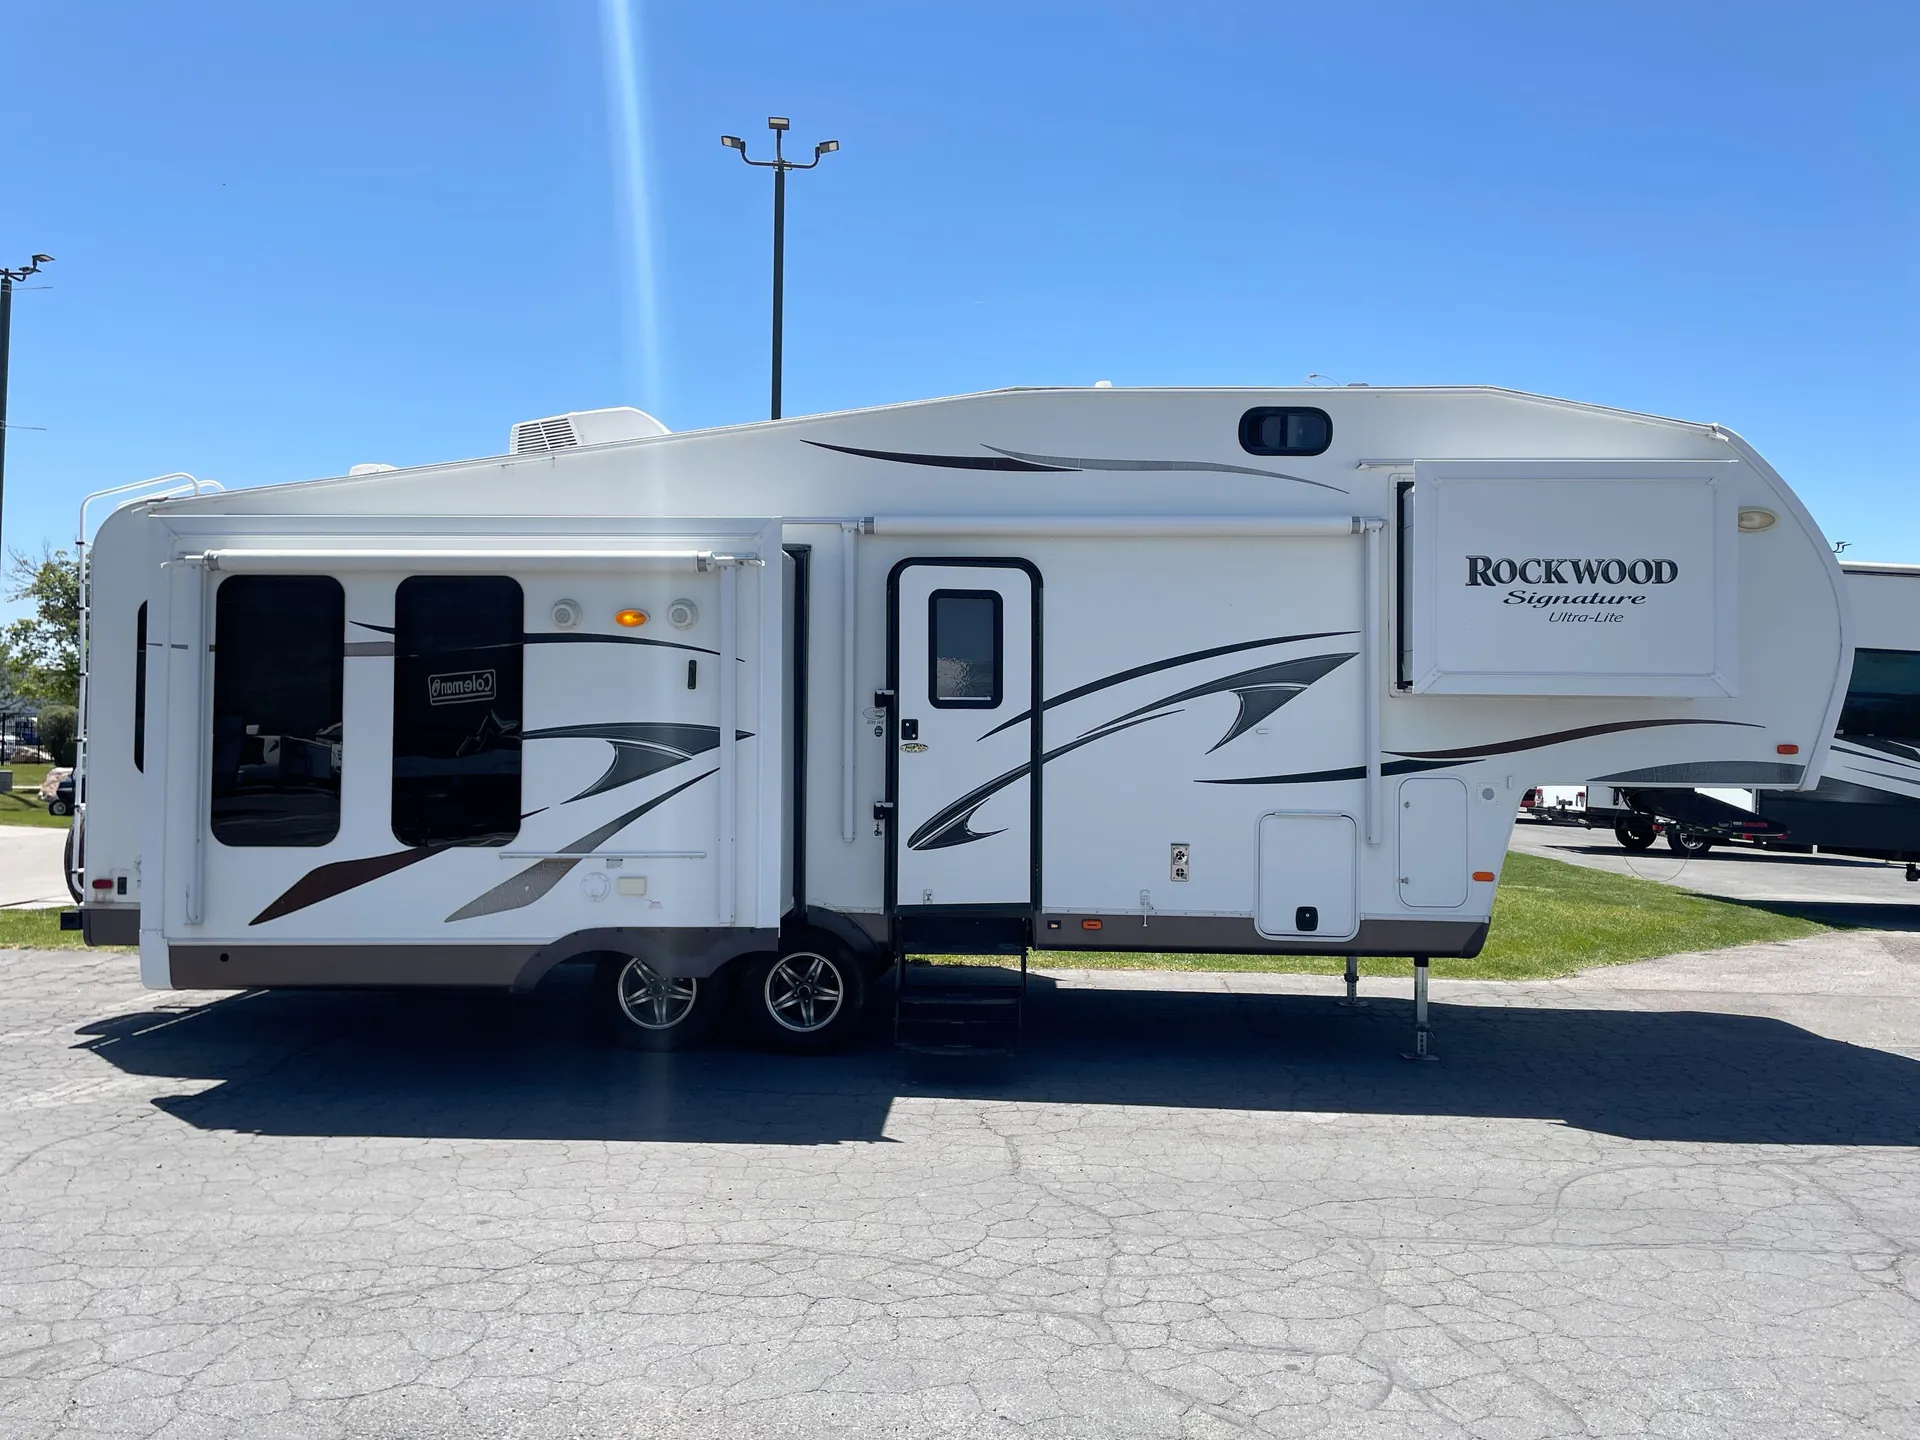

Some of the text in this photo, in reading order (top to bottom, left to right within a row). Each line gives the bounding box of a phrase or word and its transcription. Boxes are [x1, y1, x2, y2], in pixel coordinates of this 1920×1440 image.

[1465, 555, 1678, 586] ROCKWOOD
[1503, 590, 1646, 608] Signature
[1548, 612, 1624, 623] Ultra-Lite
